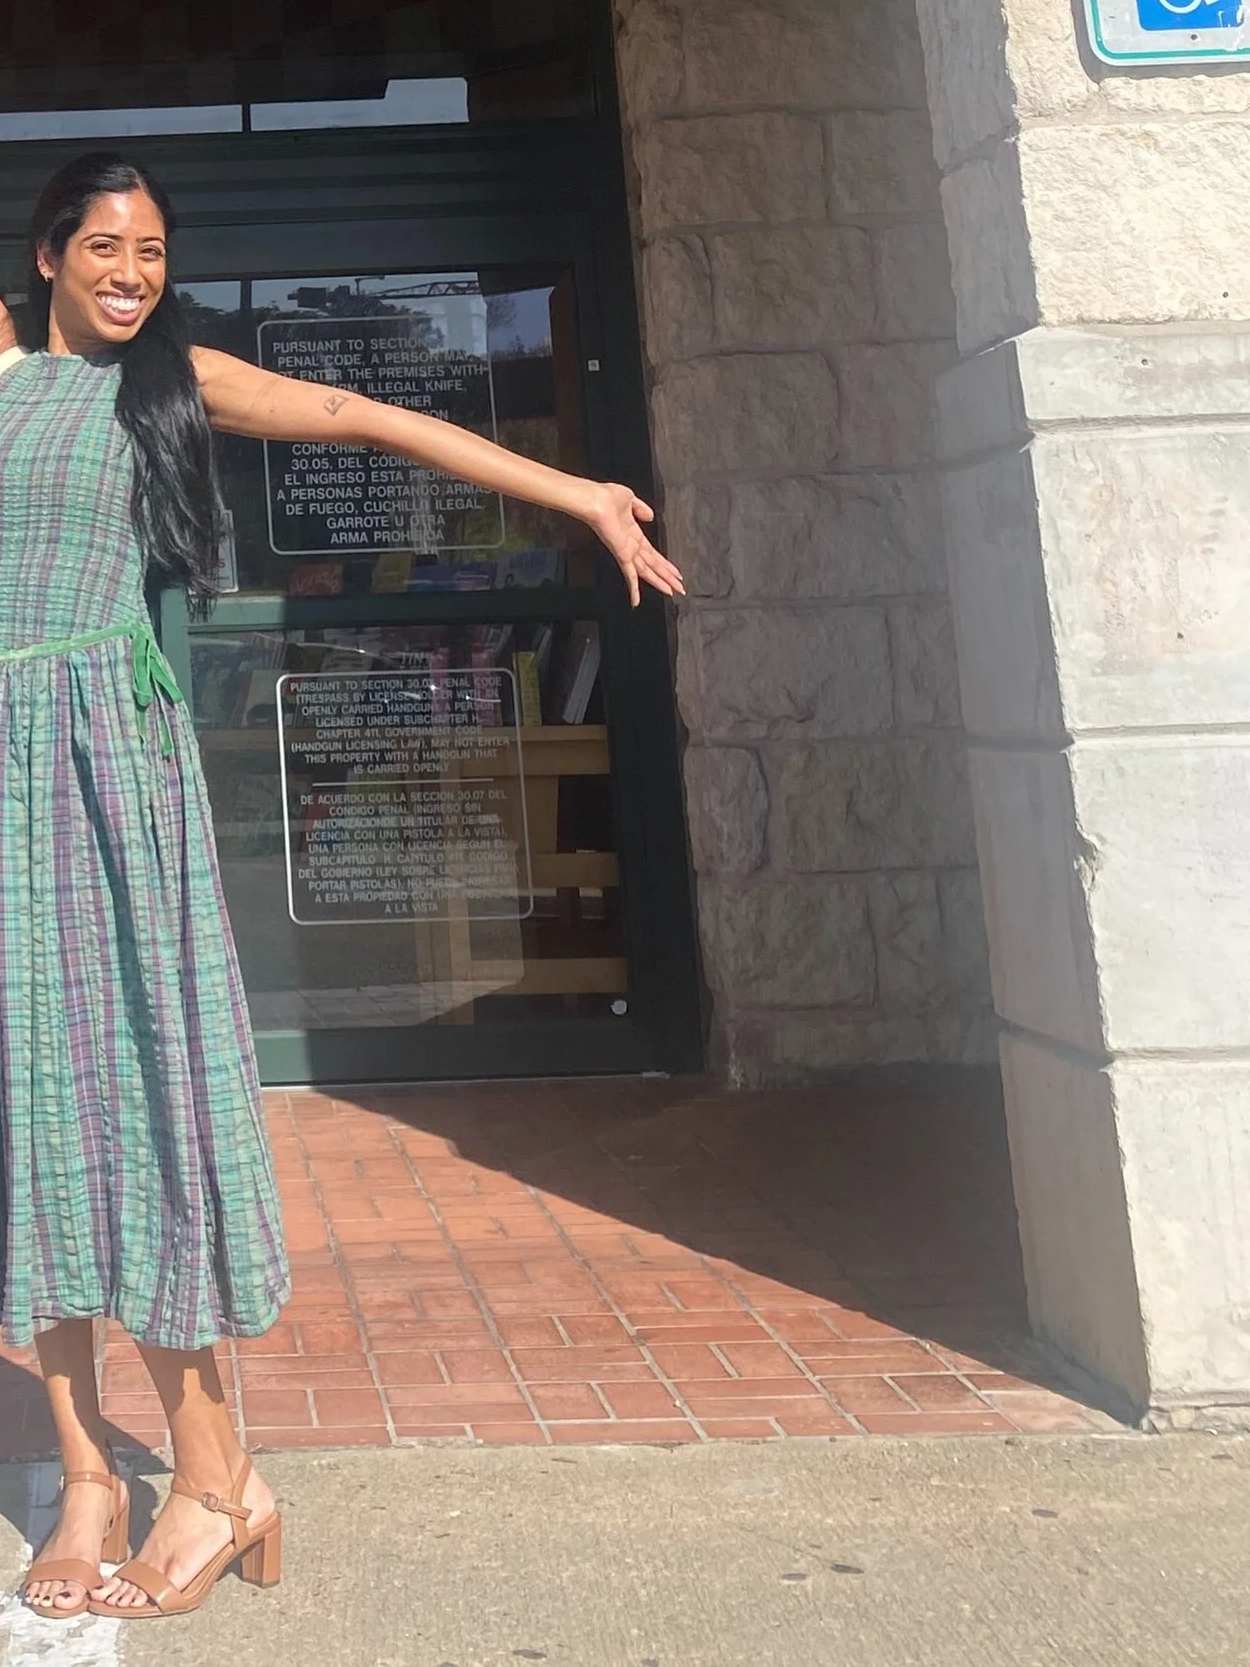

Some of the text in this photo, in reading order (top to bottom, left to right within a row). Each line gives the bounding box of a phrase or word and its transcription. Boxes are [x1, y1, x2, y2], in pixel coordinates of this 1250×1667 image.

[273, 338, 427, 354] PURSUANT TO SECTION
[277, 355, 318, 368] PENAL
[370, 353, 380, 365] A
[385, 351, 438, 364] PERSON
[299, 368, 342, 382] ENTER
[347, 367, 373, 380] THE
[378, 364, 445, 379] PREMISES
[367, 380, 420, 394] ILLEGAL
[387, 395, 432, 407] OTHER
[292, 443, 368, 456] CONFORME
[337, 457, 365, 470] DEL
[285, 470, 404, 486] EL INGRESO ESTA
[276, 489, 286, 502] A
[291, 486, 362, 500] PERSONAS
[368, 484, 439, 498] PORTANDO
[285, 503, 304, 516] DE
[326, 513, 446, 530] GARROTE U OTRA
[330, 531, 368, 545] ARMA
[290, 676, 502, 693] PURSUANT TO SECTION PENAL CODE
[352, 692, 365, 702] BY
[457, 689, 481, 700] WITH
[301, 705, 338, 716] OPENLY
[341, 704, 384, 715] CARRIED
[315, 713, 469, 727] LICENSED UNDER SUBCHAPTER
[316, 728, 361, 739] CHAPTER
[385, 725, 451, 737] GOVERNMENT
[291, 741, 342, 754] (HANDGUN
[346, 739, 397, 751] LICENSING
[431, 737, 451, 748] MAY
[454, 736, 474, 748] NOT
[477, 735, 510, 747] ENTER
[304, 748, 499, 765] THIS PROPERTY WITH A HANDGUN THAT
[353, 762, 450, 774] IS CARRIED OPENLY
[300, 794, 315, 806] DE
[317, 793, 365, 805] ACUERDO
[368, 792, 390, 804] CON
[393, 792, 406, 803] LA
[410, 790, 454, 802] SECCION
[488, 789, 508, 800] DEL
[329, 806, 375, 817] CONDIGO
[378, 804, 409, 816] PENAL
[400, 816, 414, 827] UN
[306, 830, 351, 842] LICENCIA
[354, 829, 376, 841] CON
[379, 829, 399, 840] UNA
[403, 827, 443, 839] PISTOLA
[458, 826, 471, 838] LA
[308, 842, 329, 854] UNA
[332, 841, 379, 853] PERSONA
[382, 840, 405, 852] CON
[298, 868, 318, 879] DEL
[321, 866, 373, 879] GOBIERNO
[308, 879, 347, 891] PORTAR
[314, 892, 322, 903] A
[325, 891, 350, 903] ESTA
[353, 889, 408, 902] PROPIEDAD
[384, 903, 392, 914] A
[395, 902, 408, 914] LA
